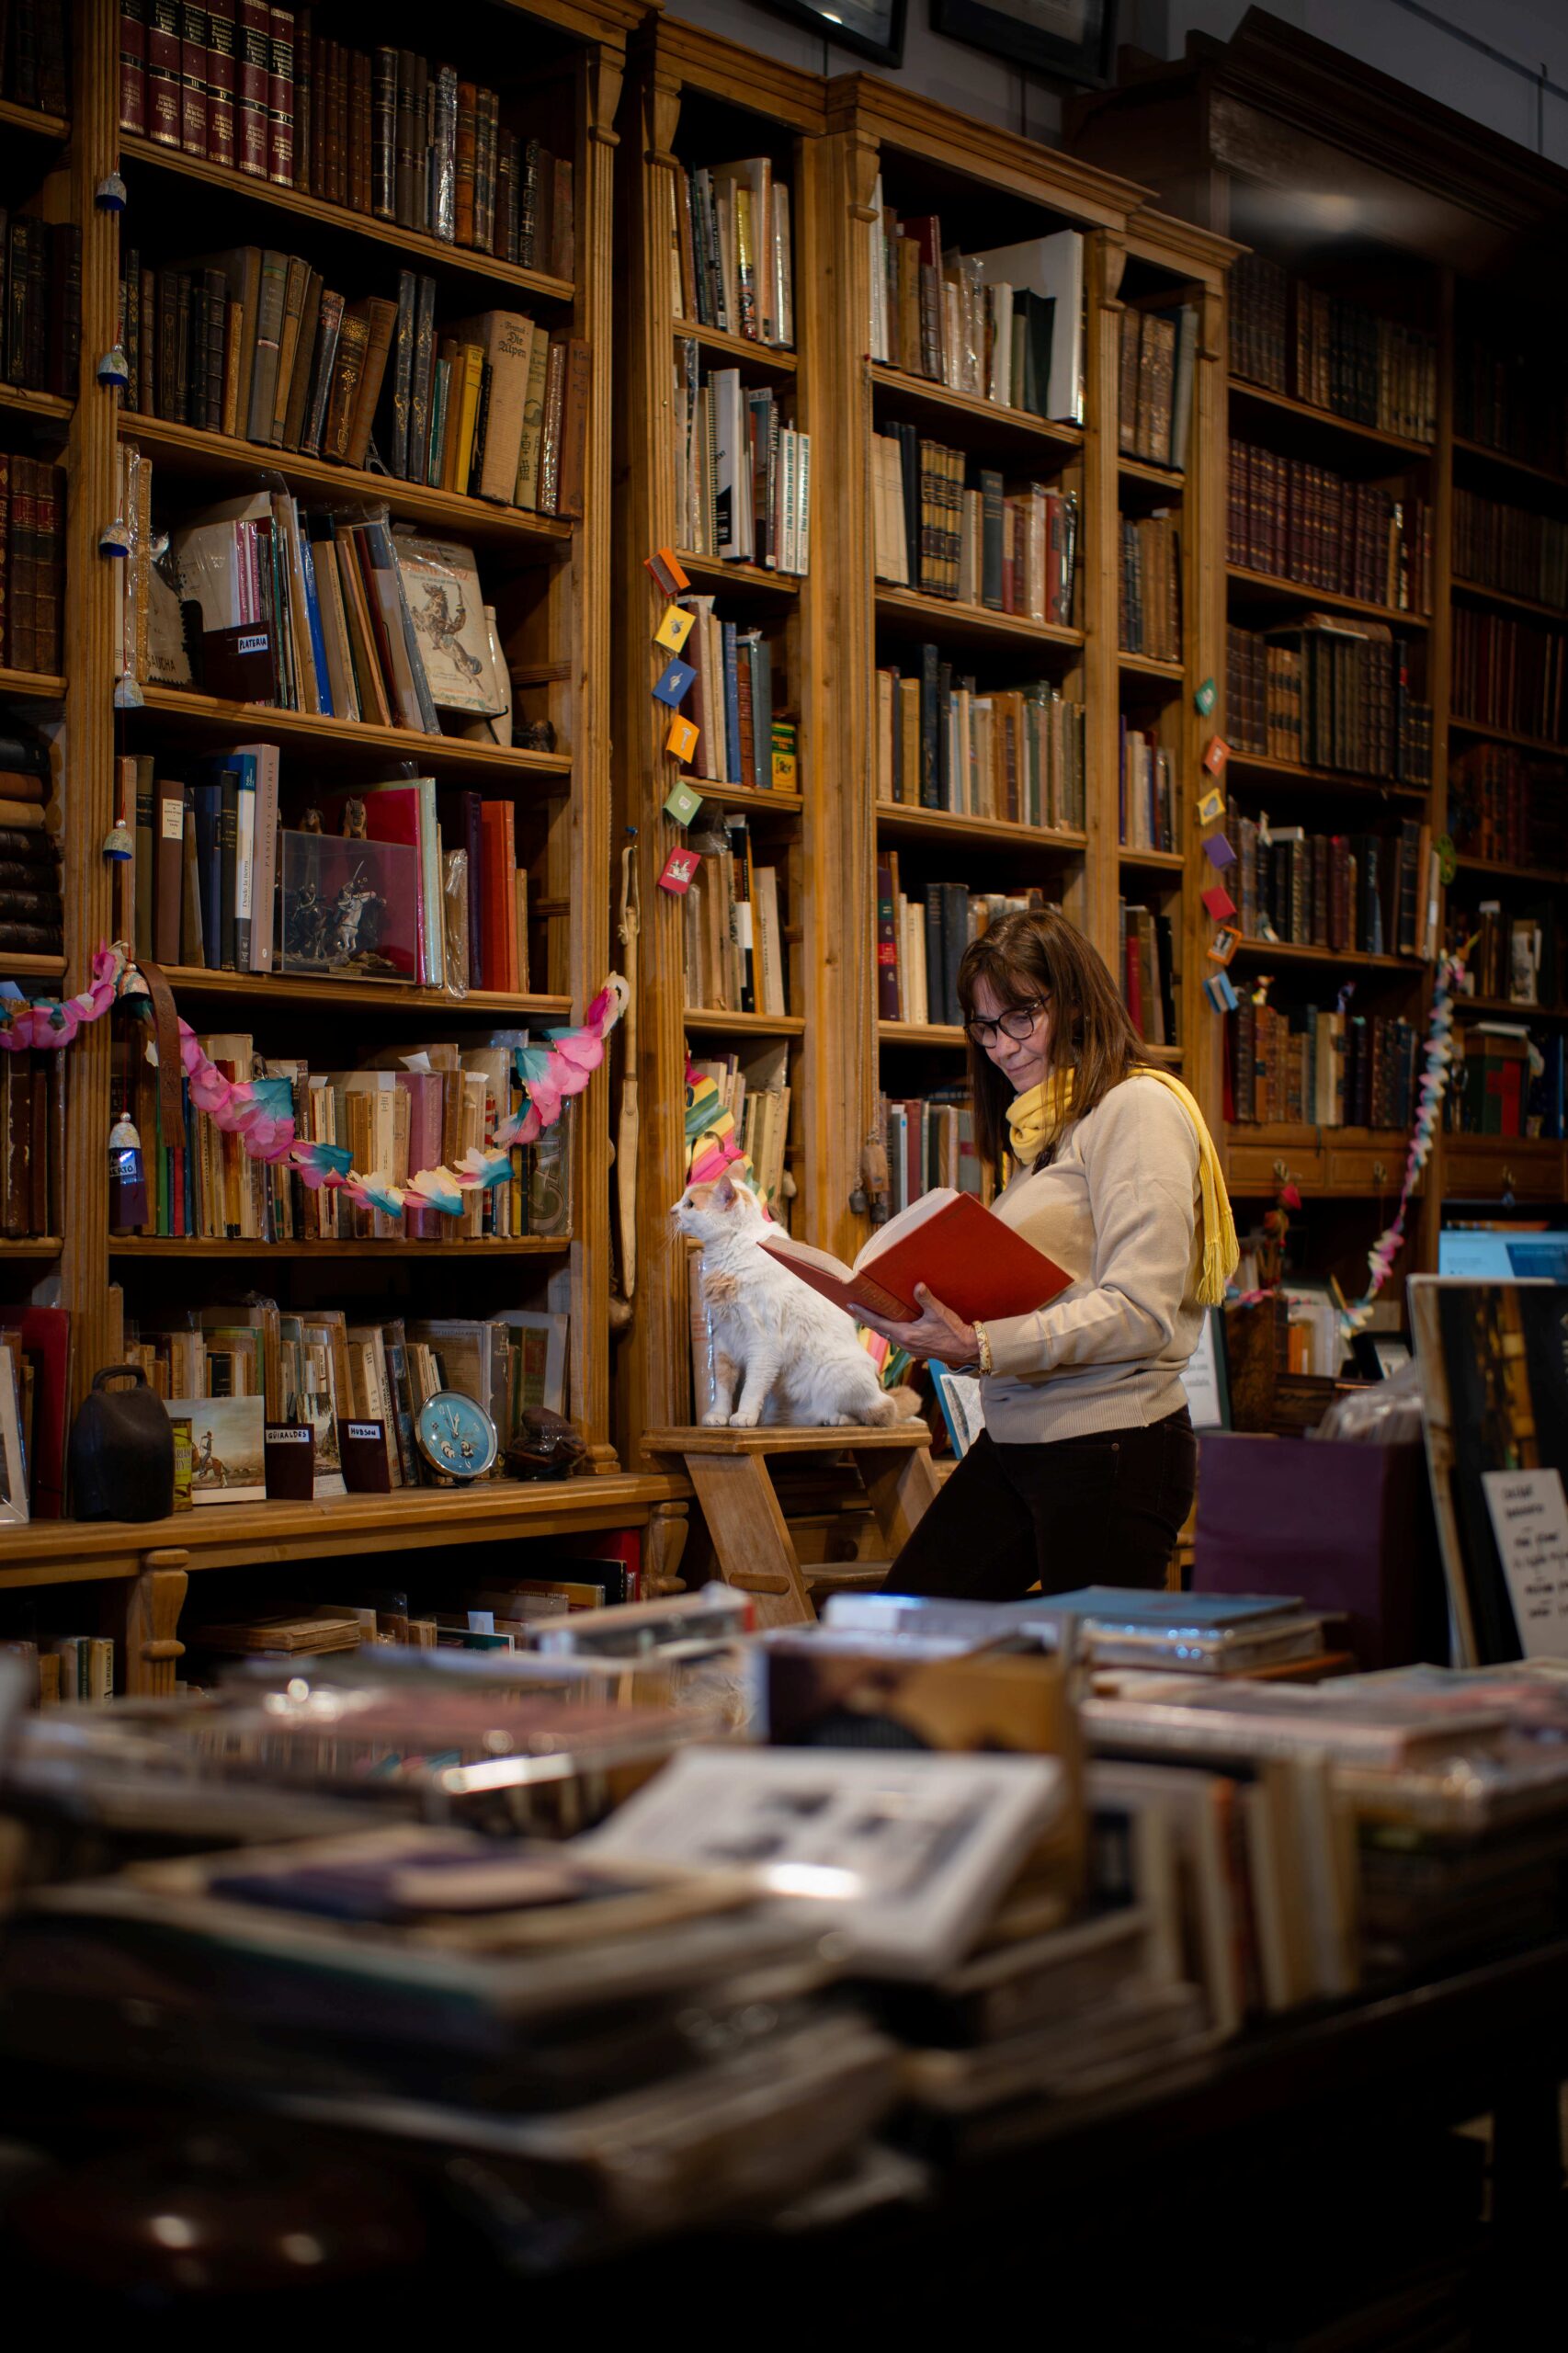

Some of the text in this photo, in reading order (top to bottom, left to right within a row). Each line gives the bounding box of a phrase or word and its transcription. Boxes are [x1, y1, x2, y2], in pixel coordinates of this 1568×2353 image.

[220, 90, 228, 99] IV
[507, 331, 523, 346] Die
[498, 339, 527, 358] Alpen
[239, 637, 267, 650] PLATERIA
[267, 1429, 308, 1440] GÜIRALDES
[350, 1427, 376, 1437] HUDSON
